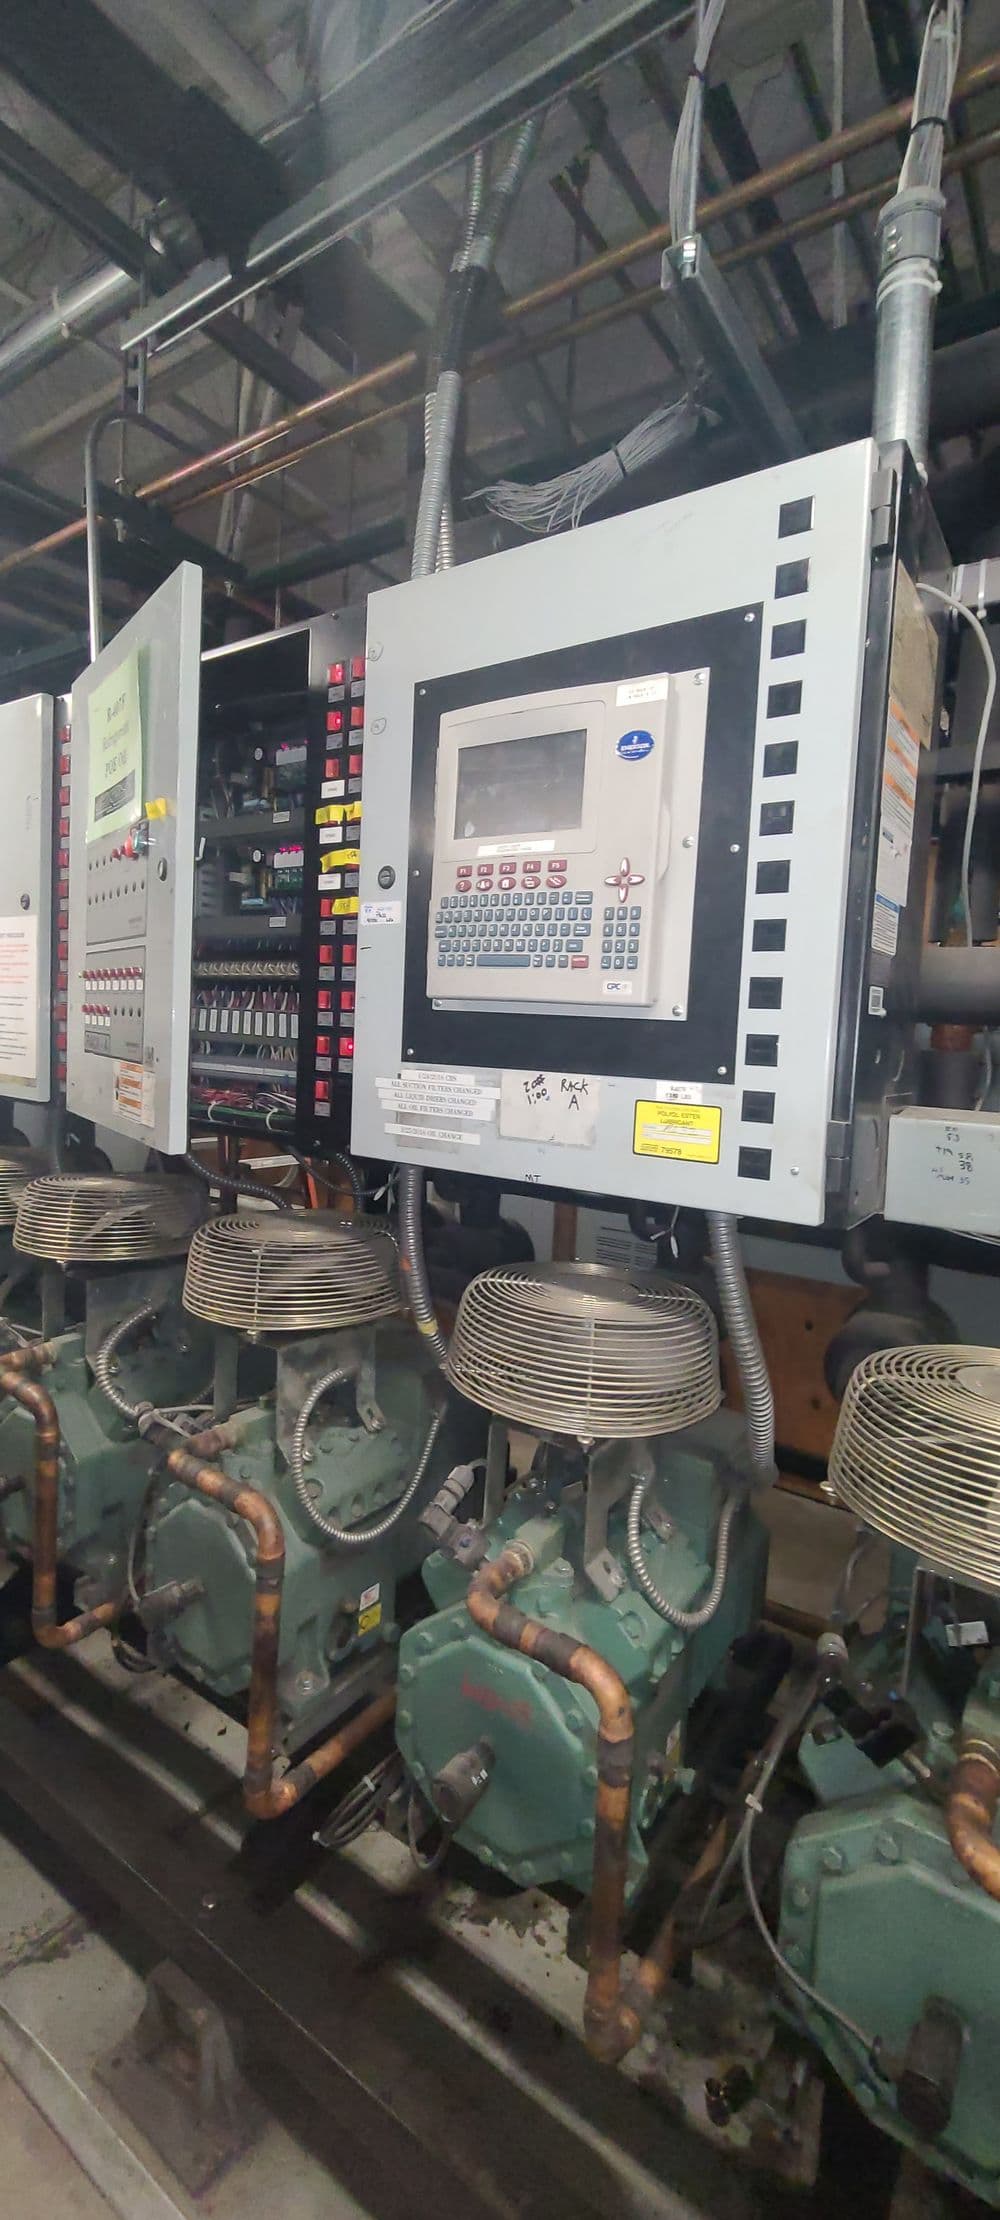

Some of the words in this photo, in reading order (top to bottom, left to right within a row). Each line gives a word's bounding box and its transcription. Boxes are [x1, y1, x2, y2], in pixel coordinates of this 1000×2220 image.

[453, 1087, 482, 1095] CHANGED
[560, 1078, 588, 1095] RACK
[568, 1094, 579, 1111] A
